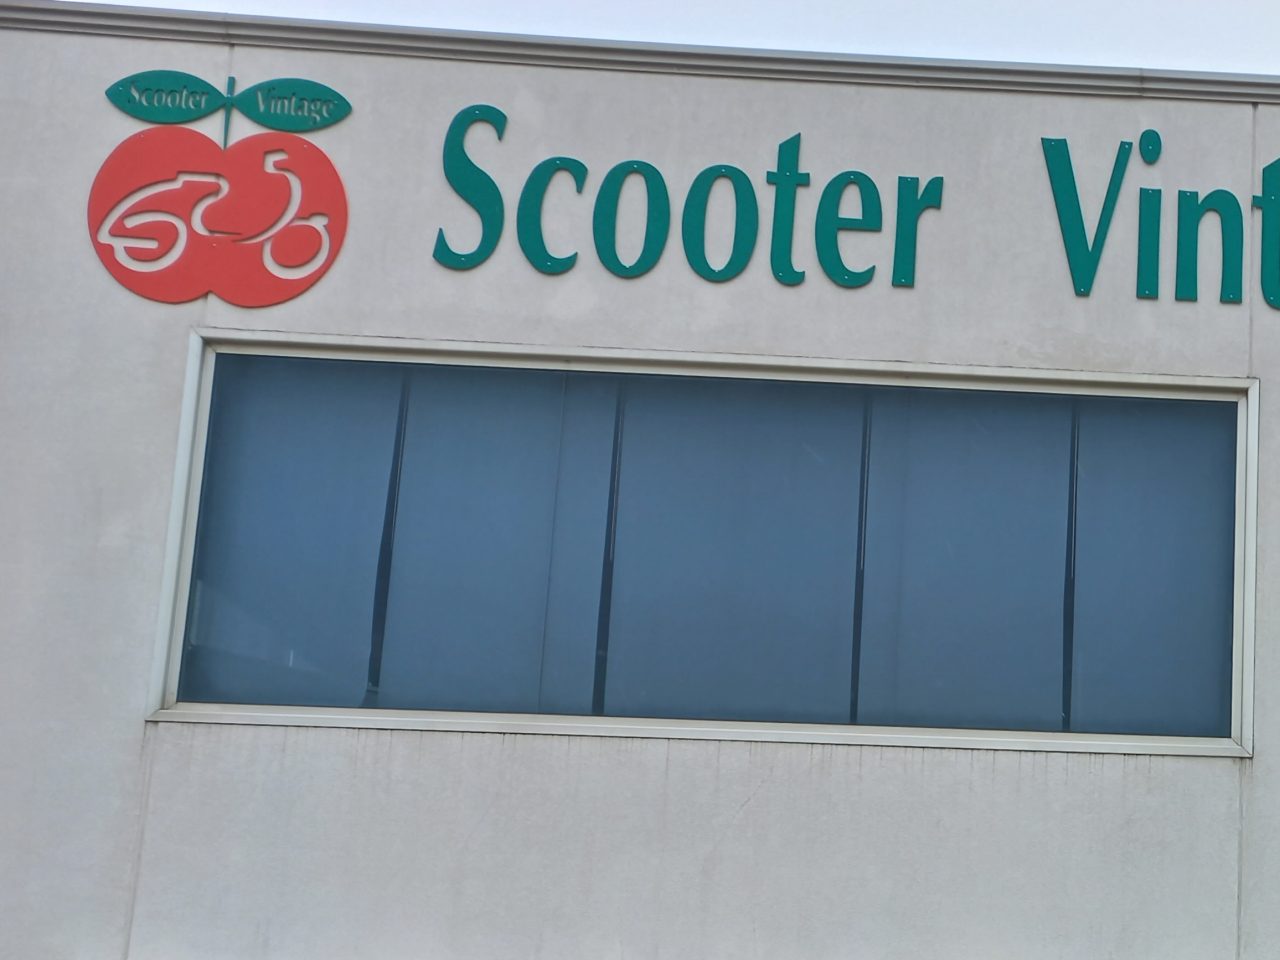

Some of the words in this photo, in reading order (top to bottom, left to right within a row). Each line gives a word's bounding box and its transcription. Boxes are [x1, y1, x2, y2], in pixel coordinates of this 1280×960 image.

[128, 79, 211, 110] Scooter
[256, 87, 336, 125] Vintage
[432, 103, 944, 289] Scooter
